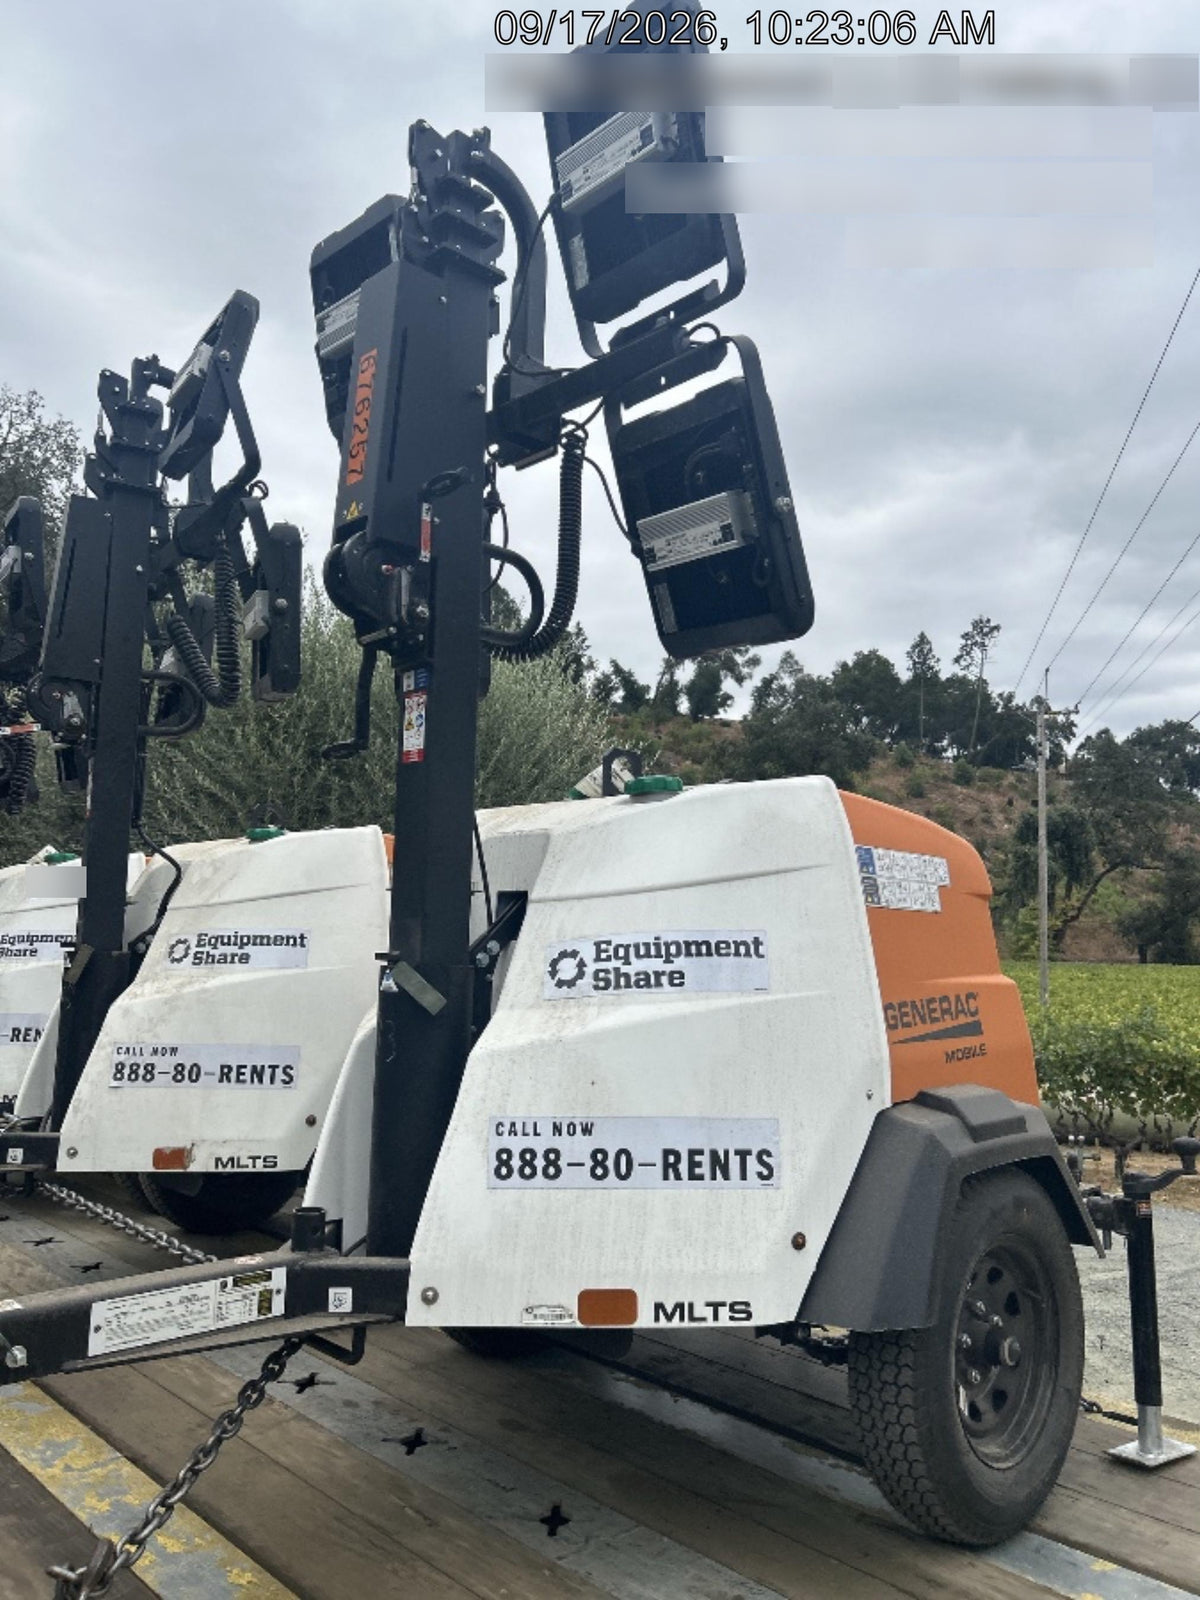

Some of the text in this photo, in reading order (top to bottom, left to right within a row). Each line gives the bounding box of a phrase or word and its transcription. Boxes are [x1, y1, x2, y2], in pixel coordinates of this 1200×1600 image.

[195, 932, 307, 949] Equipment
[593, 937, 765, 965] Equipment
[191, 950, 250, 965] Share
[592, 967, 686, 991] Share
[884, 992, 979, 1030] GENERAC
[116, 1046, 179, 1057] CALL NOW
[945, 1043, 987, 1064] MOBILE
[112, 1062, 295, 1085] 888-80-RENTS
[495, 1120, 595, 1137] CALL NOW
[214, 1155, 278, 1170] MLTS
[493, 1147, 775, 1182] 888-80-RENTS
[653, 1301, 753, 1323] MLTS
